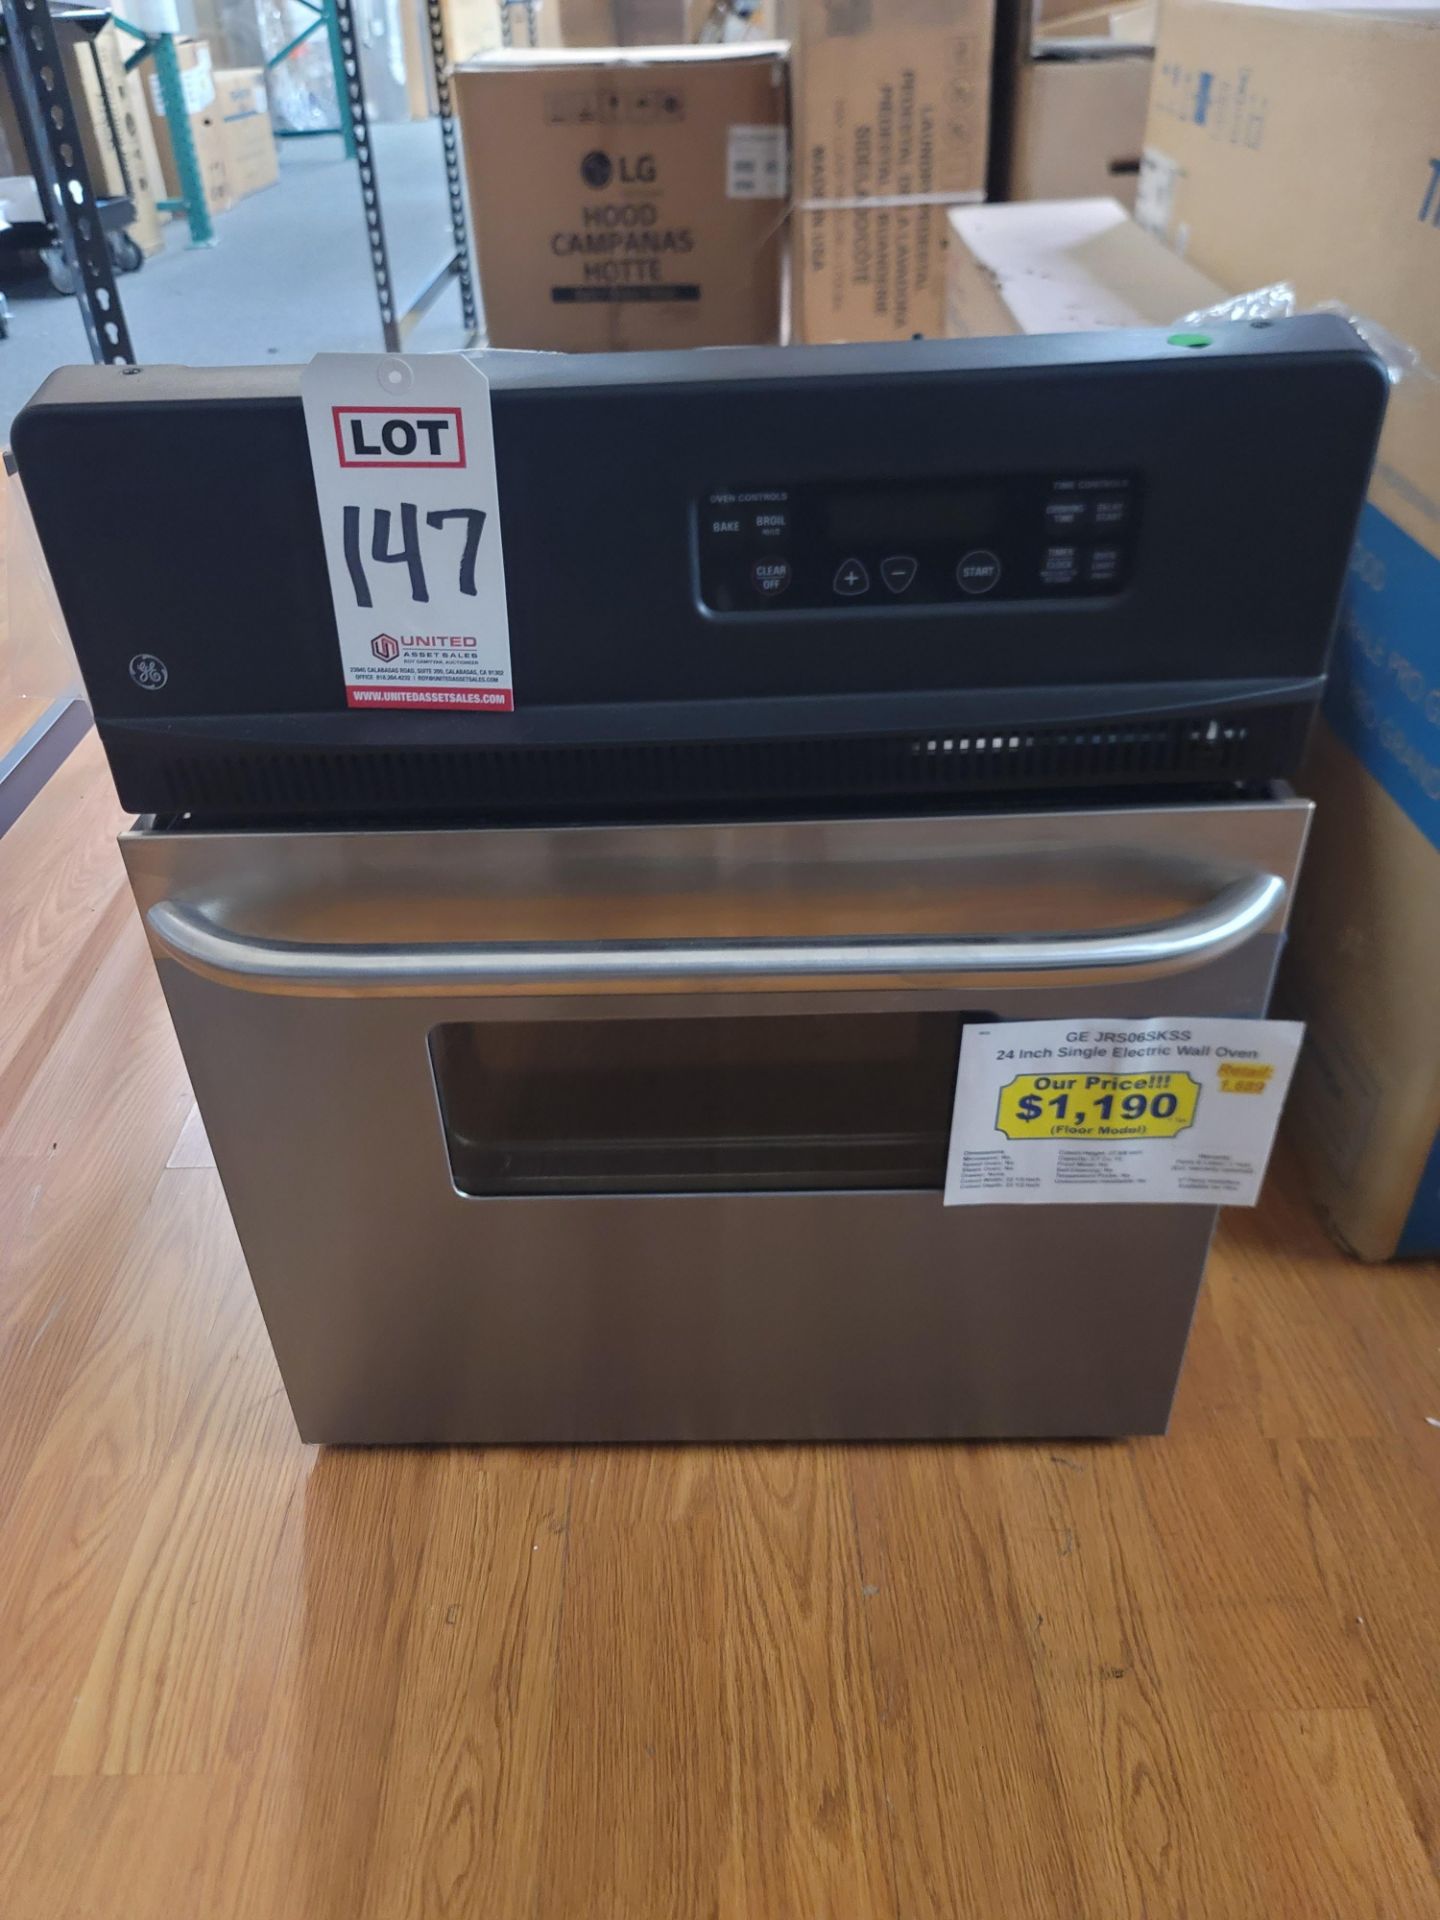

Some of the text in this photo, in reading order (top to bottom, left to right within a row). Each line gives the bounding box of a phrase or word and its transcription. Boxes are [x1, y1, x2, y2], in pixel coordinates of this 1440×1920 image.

[619, 155, 657, 183] LG
[582, 204, 658, 229] HOOD
[550, 229, 694, 256] CAMPANAS
[583, 258, 660, 282] HOTTE
[350, 419, 449, 456] LOT
[710, 492, 788, 504] OVEN CONTROLS
[713, 521, 740, 533] BAKE
[756, 515, 786, 526] BROIL
[343, 502, 487, 609] 147
[756, 565, 786, 577] CLEAR
[962, 565, 994, 579] START
[762, 580, 780, 590] OFF
[400, 635, 478, 648] UNITED
[353, 690, 505, 704] WWW.UNITEDASSETSALES.COM
[1066, 1030, 1192, 1043] GE JRS06SKSS
[996, 1046, 1259, 1061] 24 Inch Single Electric Wall Oven
[1033, 1075, 1172, 1091] Our Price!!!
[1015, 1093, 1179, 1125] $1,190
[1050, 1125, 1148, 1137] (Floor Model)
